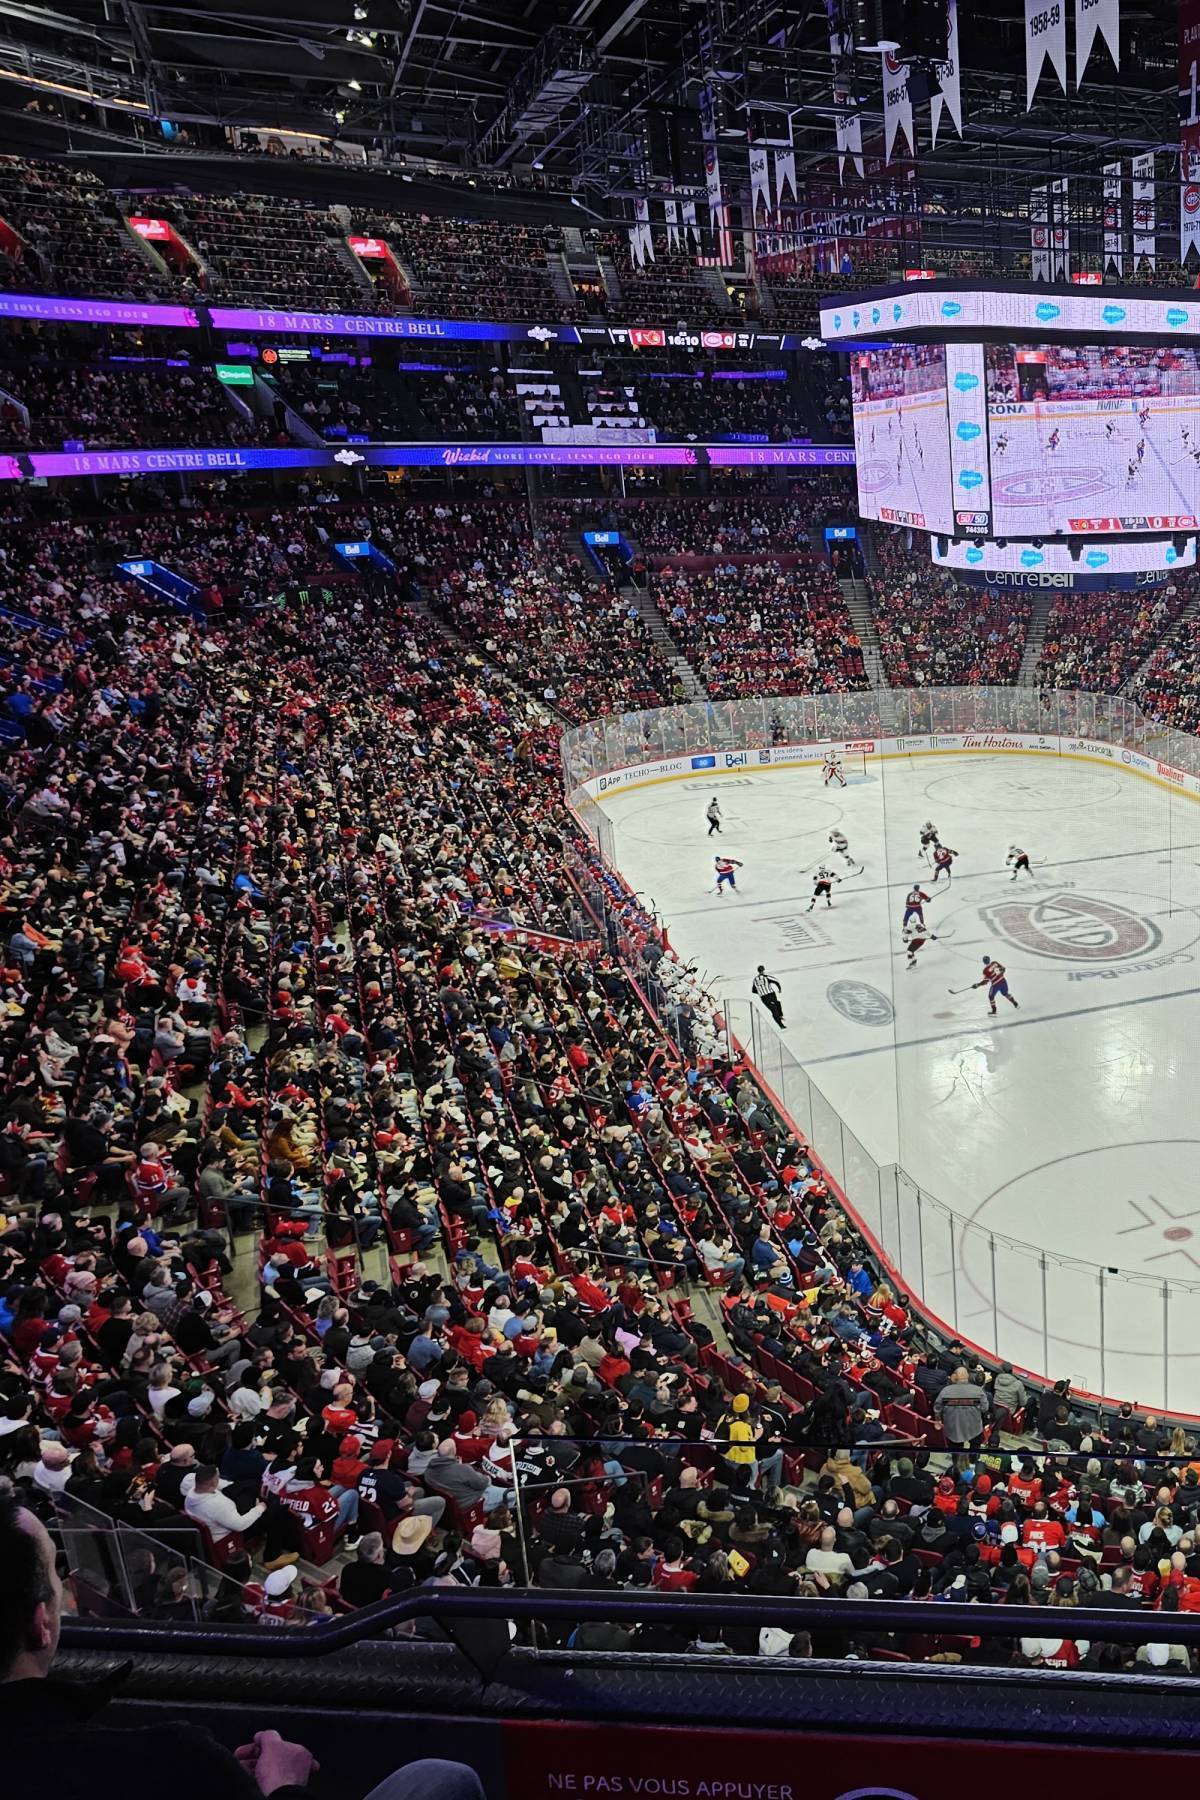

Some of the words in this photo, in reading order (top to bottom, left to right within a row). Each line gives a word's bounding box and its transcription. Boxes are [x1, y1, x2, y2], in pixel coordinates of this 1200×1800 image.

[1029, 4, 1060, 37] 1958-59
[1188, 60, 1199, 126] 1
[258, 315, 276, 328] 18
[284, 316, 335, 330] MARS
[344, 320, 404, 334] CENTRE
[408, 322, 445, 336] BELL
[74, 457, 90, 470] 18
[99, 455, 140, 470] MARS
[146, 454, 203, 468] CENTRE
[207, 453, 245, 466] BELL
[442, 448, 491, 464] Wizkid
[750, 452, 764, 462] 18
[773, 451, 817, 462] MARS
[825, 450, 856, 462] CENT
[984, 571, 1074, 588] CentreBell
[962, 735, 982, 748] Tim
[984, 735, 1023, 749] Hortons
[726, 752, 748, 768] Bell
[1156, 763, 1185, 782] Qualinet
[548, 1773, 576, 1790] NE
[584, 1775, 623, 1792] PAS
[628, 1777, 689, 1795] VOUS
[696, 1781, 792, 1800] APPUYER
